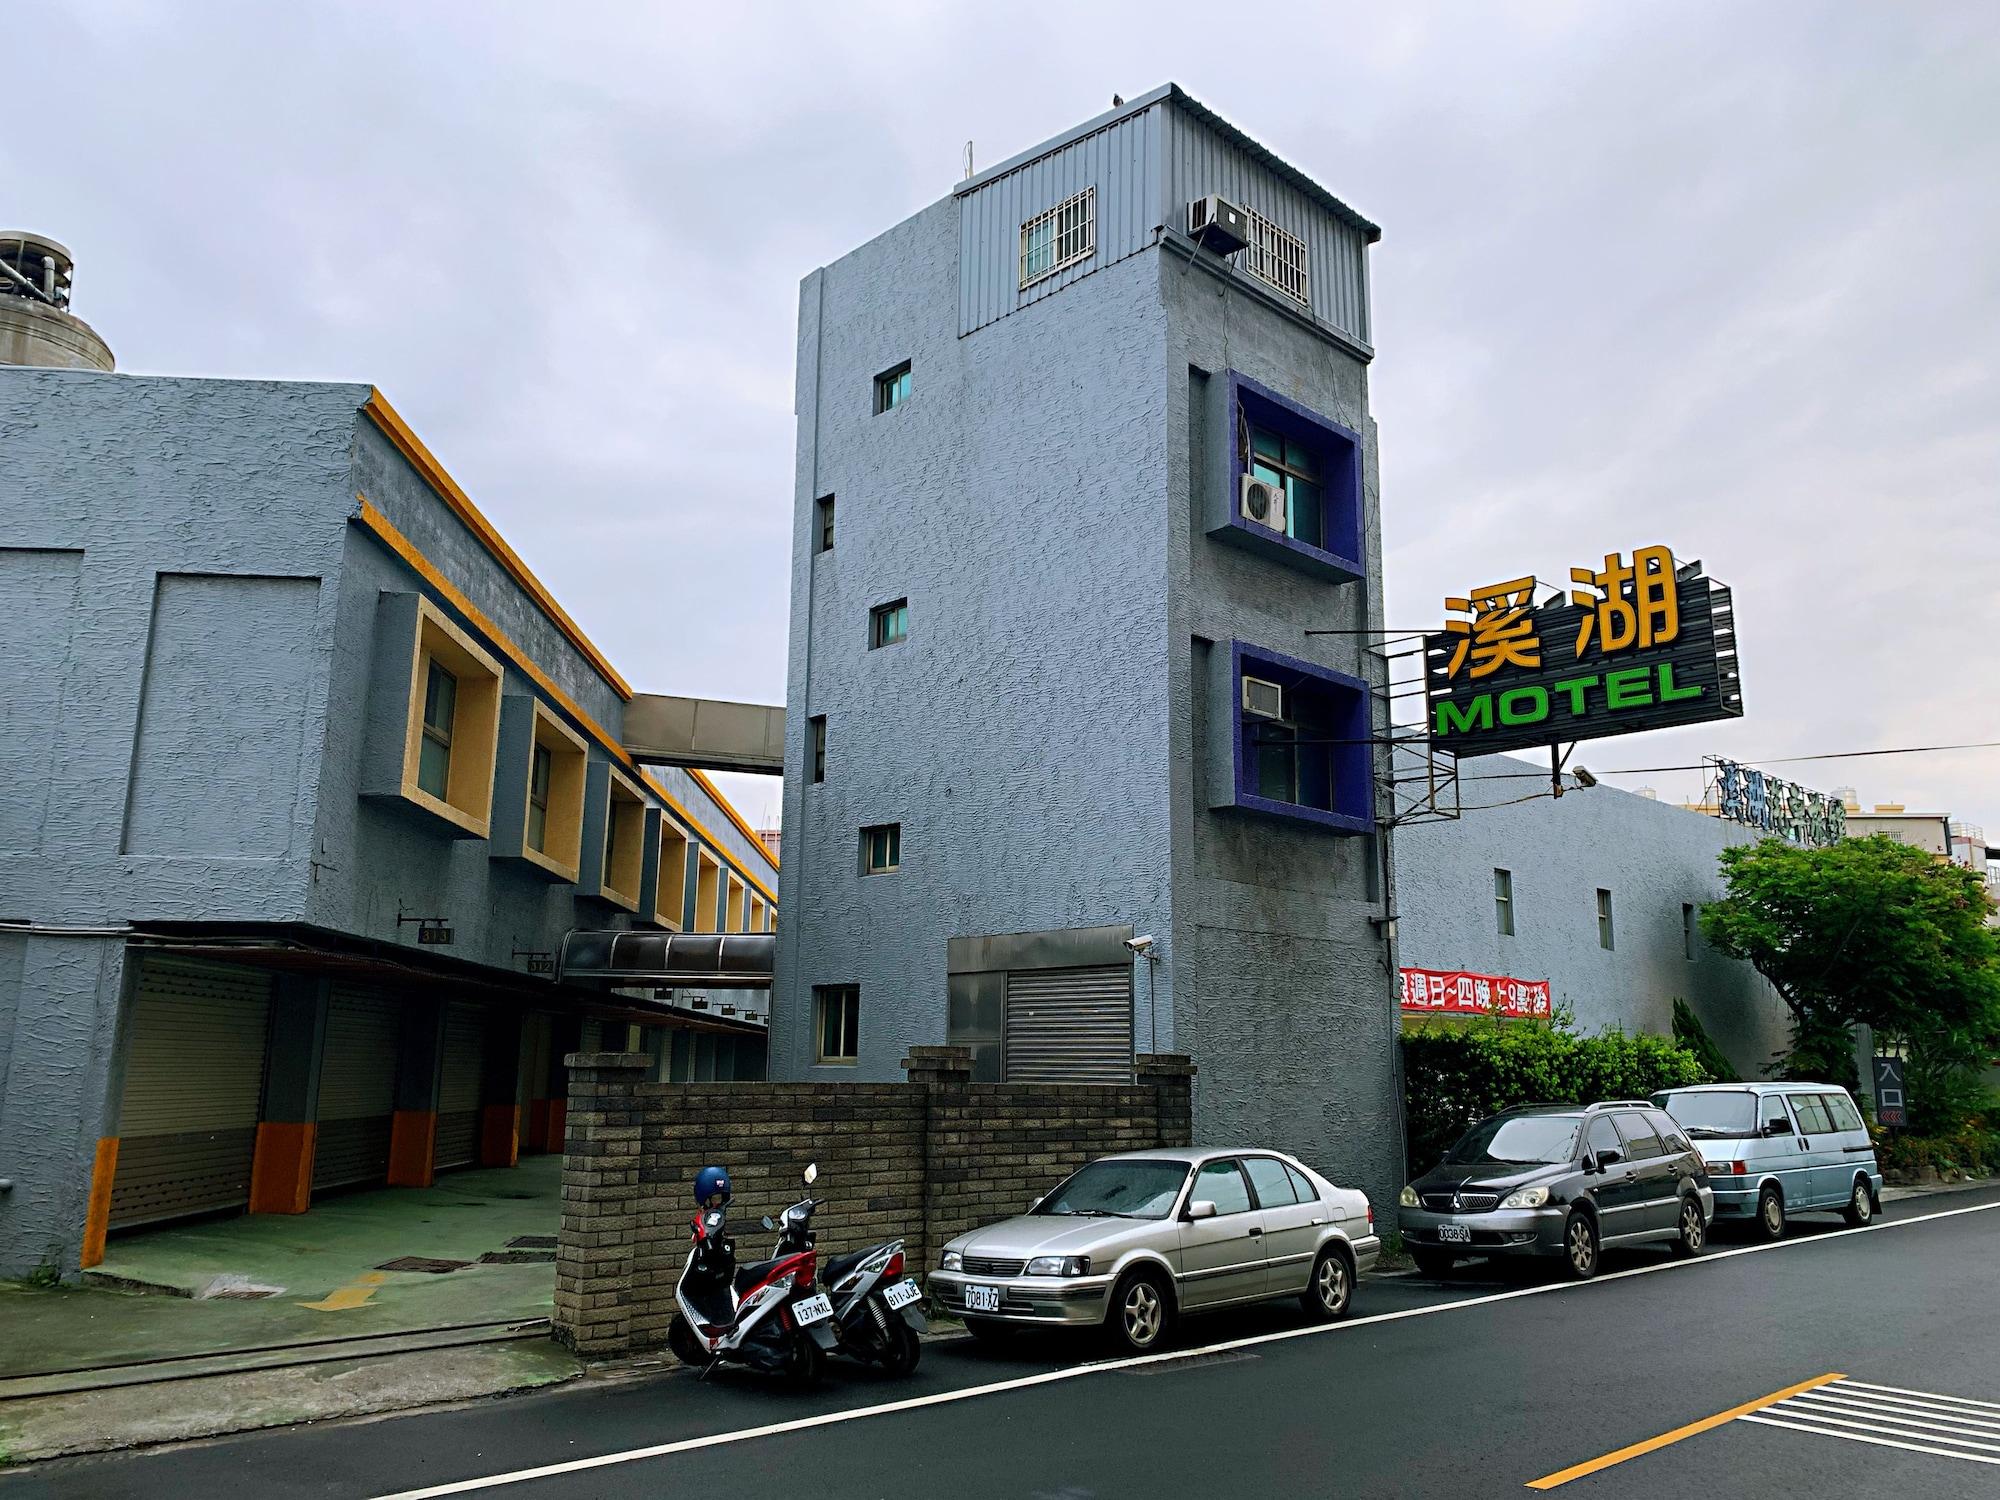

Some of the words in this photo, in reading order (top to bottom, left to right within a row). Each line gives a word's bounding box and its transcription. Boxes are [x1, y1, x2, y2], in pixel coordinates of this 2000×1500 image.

[1445, 545, 1679, 679] 溪湖
[1436, 663, 1703, 736] MOTEL
[422, 930, 447, 942] 313
[529, 962, 551, 971] 312
[1880, 1063, 1903, 1107] 入口
[888, 1287, 919, 1306] 811-JJE
[966, 1290, 998, 1307] 7081-XZ
[797, 1301, 831, 1322] 137-NXL
